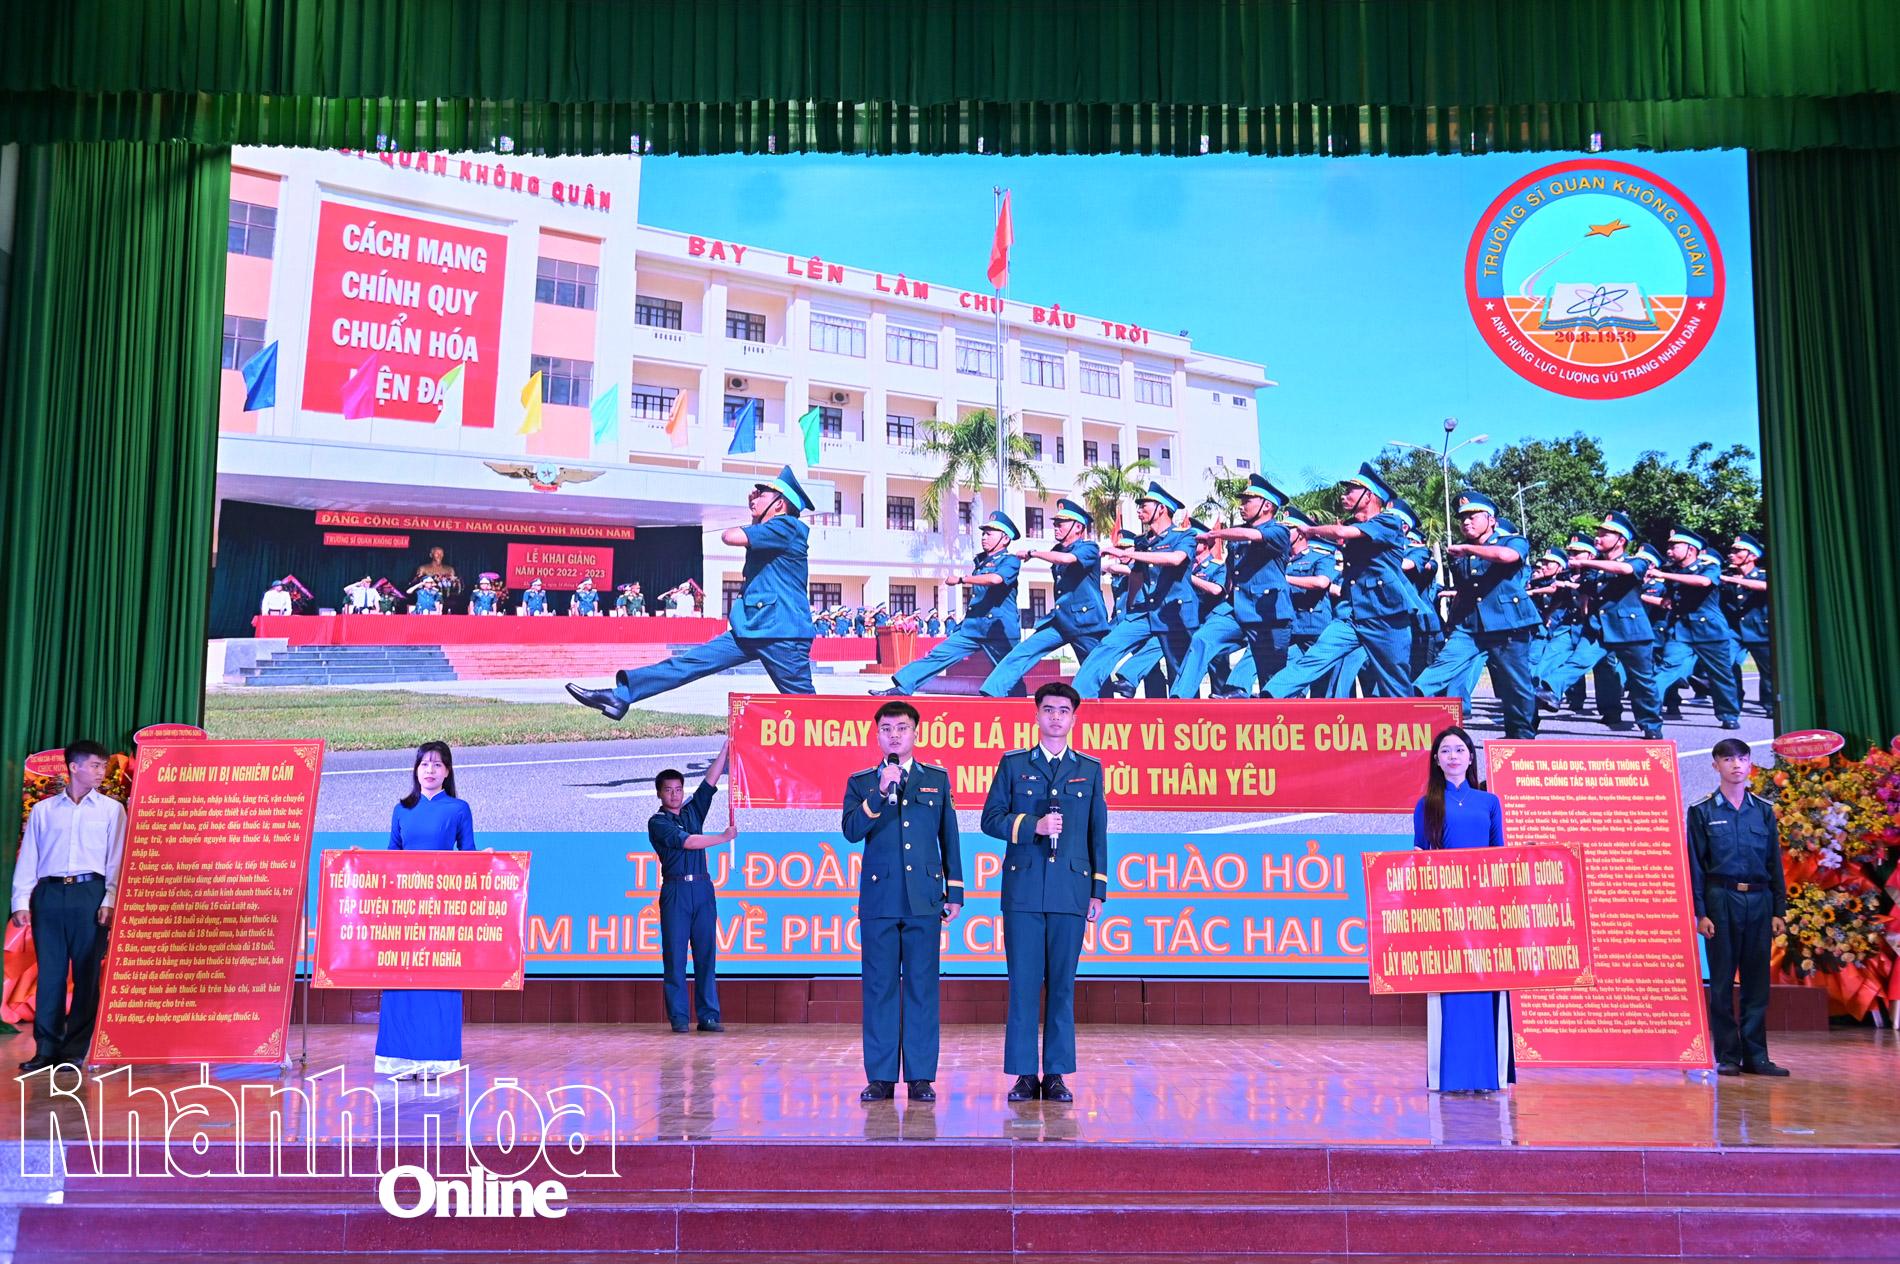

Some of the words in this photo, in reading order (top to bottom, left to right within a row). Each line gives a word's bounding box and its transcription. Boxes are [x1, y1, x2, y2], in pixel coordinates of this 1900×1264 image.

[342, 220, 411, 261] CÁCH
[416, 236, 488, 273] MẠNG
[1484, 205, 1527, 278] TRƯỜNG
[1525, 187, 1546, 208] SĨ
[1549, 176, 1605, 197] QUAN
[1613, 179, 1679, 223] KHÔNG
[1676, 223, 1708, 277] QUÂN
[688, 236, 748, 265] BAY
[787, 255, 844, 285] LÊN
[341, 269, 421, 309] CHÍNH
[427, 284, 479, 317] QUY
[332, 312, 422, 355] CHUẨN
[428, 327, 479, 363] HÓA
[1491, 315, 1510, 339] ANH
[1506, 335, 1535, 362] HÙNG
[1533, 357, 1557, 376] LỰC
[1558, 365, 1600, 384] LƯỢNG
[1602, 369, 1619, 384] VŨ
[1621, 360, 1660, 381] TRANG
[1554, 331, 1636, 344] 20.8.1959
[760, 709, 795, 747] BỎ
[804, 718, 872, 747] NGAY
[974, 716, 1006, 749] LÁ
[1082, 722, 1140, 751] NAY
[1140, 717, 1165, 751] VÌ
[1173, 717, 1227, 752] SỨC
[1236, 714, 1305, 752] KHỎE
[1314, 713, 1369, 752] CỦA
[1376, 722, 1433, 758] BẠN
[157, 763, 178, 783] CÁC
[179, 763, 206, 783] HÀNH
[208, 765, 219, 782] VI
[219, 765, 230, 785] BỊ
[231, 762, 270, 782] NGHIÊM
[271, 760, 294, 781] CẤM
[1147, 762, 1218, 797] THÂN
[1225, 762, 1277, 797] YÊU
[330, 869, 350, 889] TIỂU
[351, 871, 379, 889] ĐOÀN
[381, 874, 387, 889] 1
[396, 870, 434, 890] TRƯỜNG
[464, 872, 478, 890] ĐÃ
[480, 869, 494, 891] TỔ
[494, 872, 520, 891] CHỨC
[1117, 843, 1248, 891] CHÀO
[1262, 839, 1346, 892] HỎI
[1386, 860, 1405, 892] CÁN
[1405, 856, 1417, 896] BỘ
[1418, 855, 1438, 890] TIỂU
[1439, 860, 1464, 889] ĐOÀN
[1465, 866, 1471, 888] 1
[1478, 858, 1490, 888] LÀ
[1491, 857, 1509, 893] MỘT
[1510, 854, 1530, 887] TẤM
[339, 896, 357, 917] TẬP
[358, 896, 390, 918] LUYỆN
[391, 899, 416, 918] THỰC
[418, 896, 441, 919] HIỆN
[443, 900, 468, 916] THEO
[469, 895, 487, 916] CHỈ
[488, 901, 508, 920] ĐẠO
[1382, 909, 1410, 935] TRONG
[1411, 908, 1441, 934] PHONG
[1442, 902, 1465, 932] TRÀO
[1466, 900, 1499, 933] PHÒNG,
[1500, 896, 1531, 930] CHỐNG
[1531, 895, 1560, 929] THUỐC
[1560, 898, 1576, 930] LÁ,
[340, 922, 354, 941] CÓ
[356, 925, 368, 941] 10
[370, 922, 401, 941] THÀNH
[404, 922, 426, 941] VIÊN
[428, 926, 456, 942] THAM
[457, 926, 475, 942] GIA
[476, 923, 503, 942] CÙNG
[1144, 906, 1231, 953] TÁC
[1244, 915, 1323, 959] HẠI
[377, 950, 399, 967] ĐƠN
[400, 950, 411, 970] VỊ
[412, 947, 431, 967] KẾT
[431, 949, 462, 968] NGHĨA
[1383, 943, 1400, 977] LẤY
[1401, 950, 1419, 981] HỌC
[1420, 945, 1441, 975] VIÊN
[1442, 943, 1462, 974] LÀM
[1463, 948, 1492, 974] TRUNG
[1493, 942, 1516, 974] TÂM,
[1516, 941, 1544, 972] TUYÊN
[1545, 937, 1580, 970] TRUYỀN
